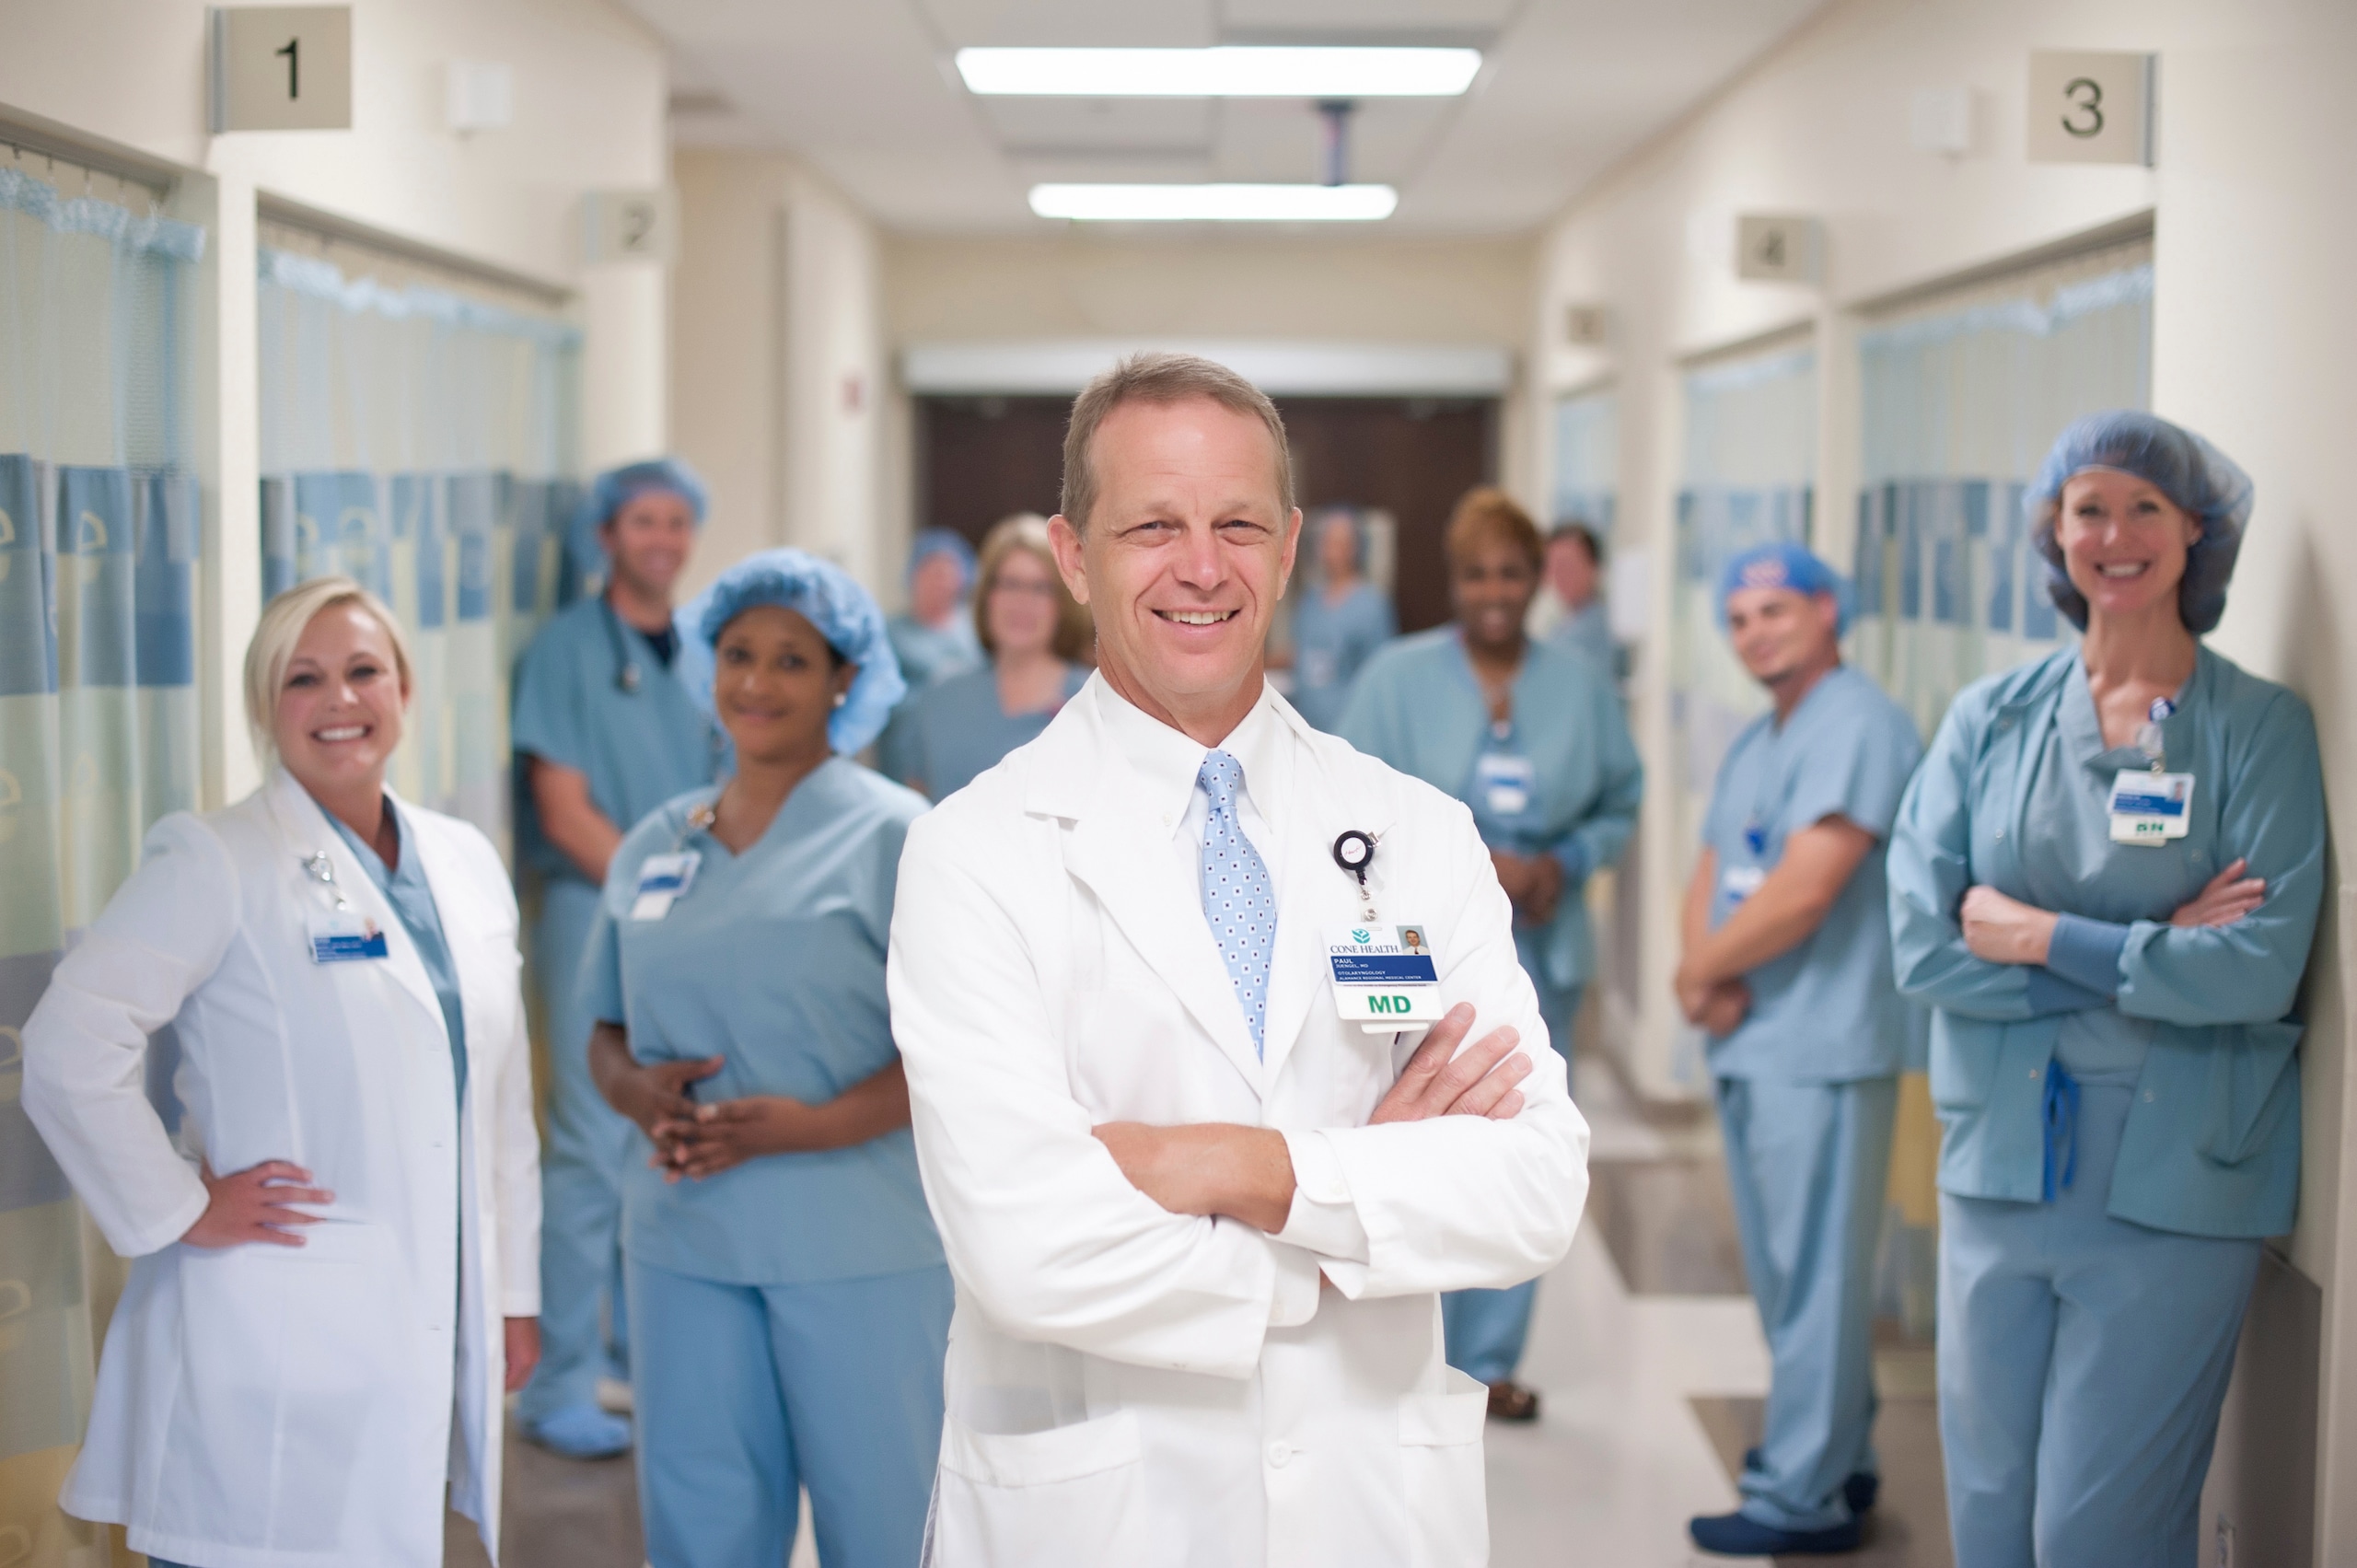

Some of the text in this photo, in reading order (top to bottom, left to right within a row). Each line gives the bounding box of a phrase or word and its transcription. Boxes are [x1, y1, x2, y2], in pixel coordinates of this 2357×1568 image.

[275, 37, 298, 100] 1
[2061, 77, 2104, 138] 3
[622, 201, 656, 250] 2
[1367, 995, 1411, 1014] MD
